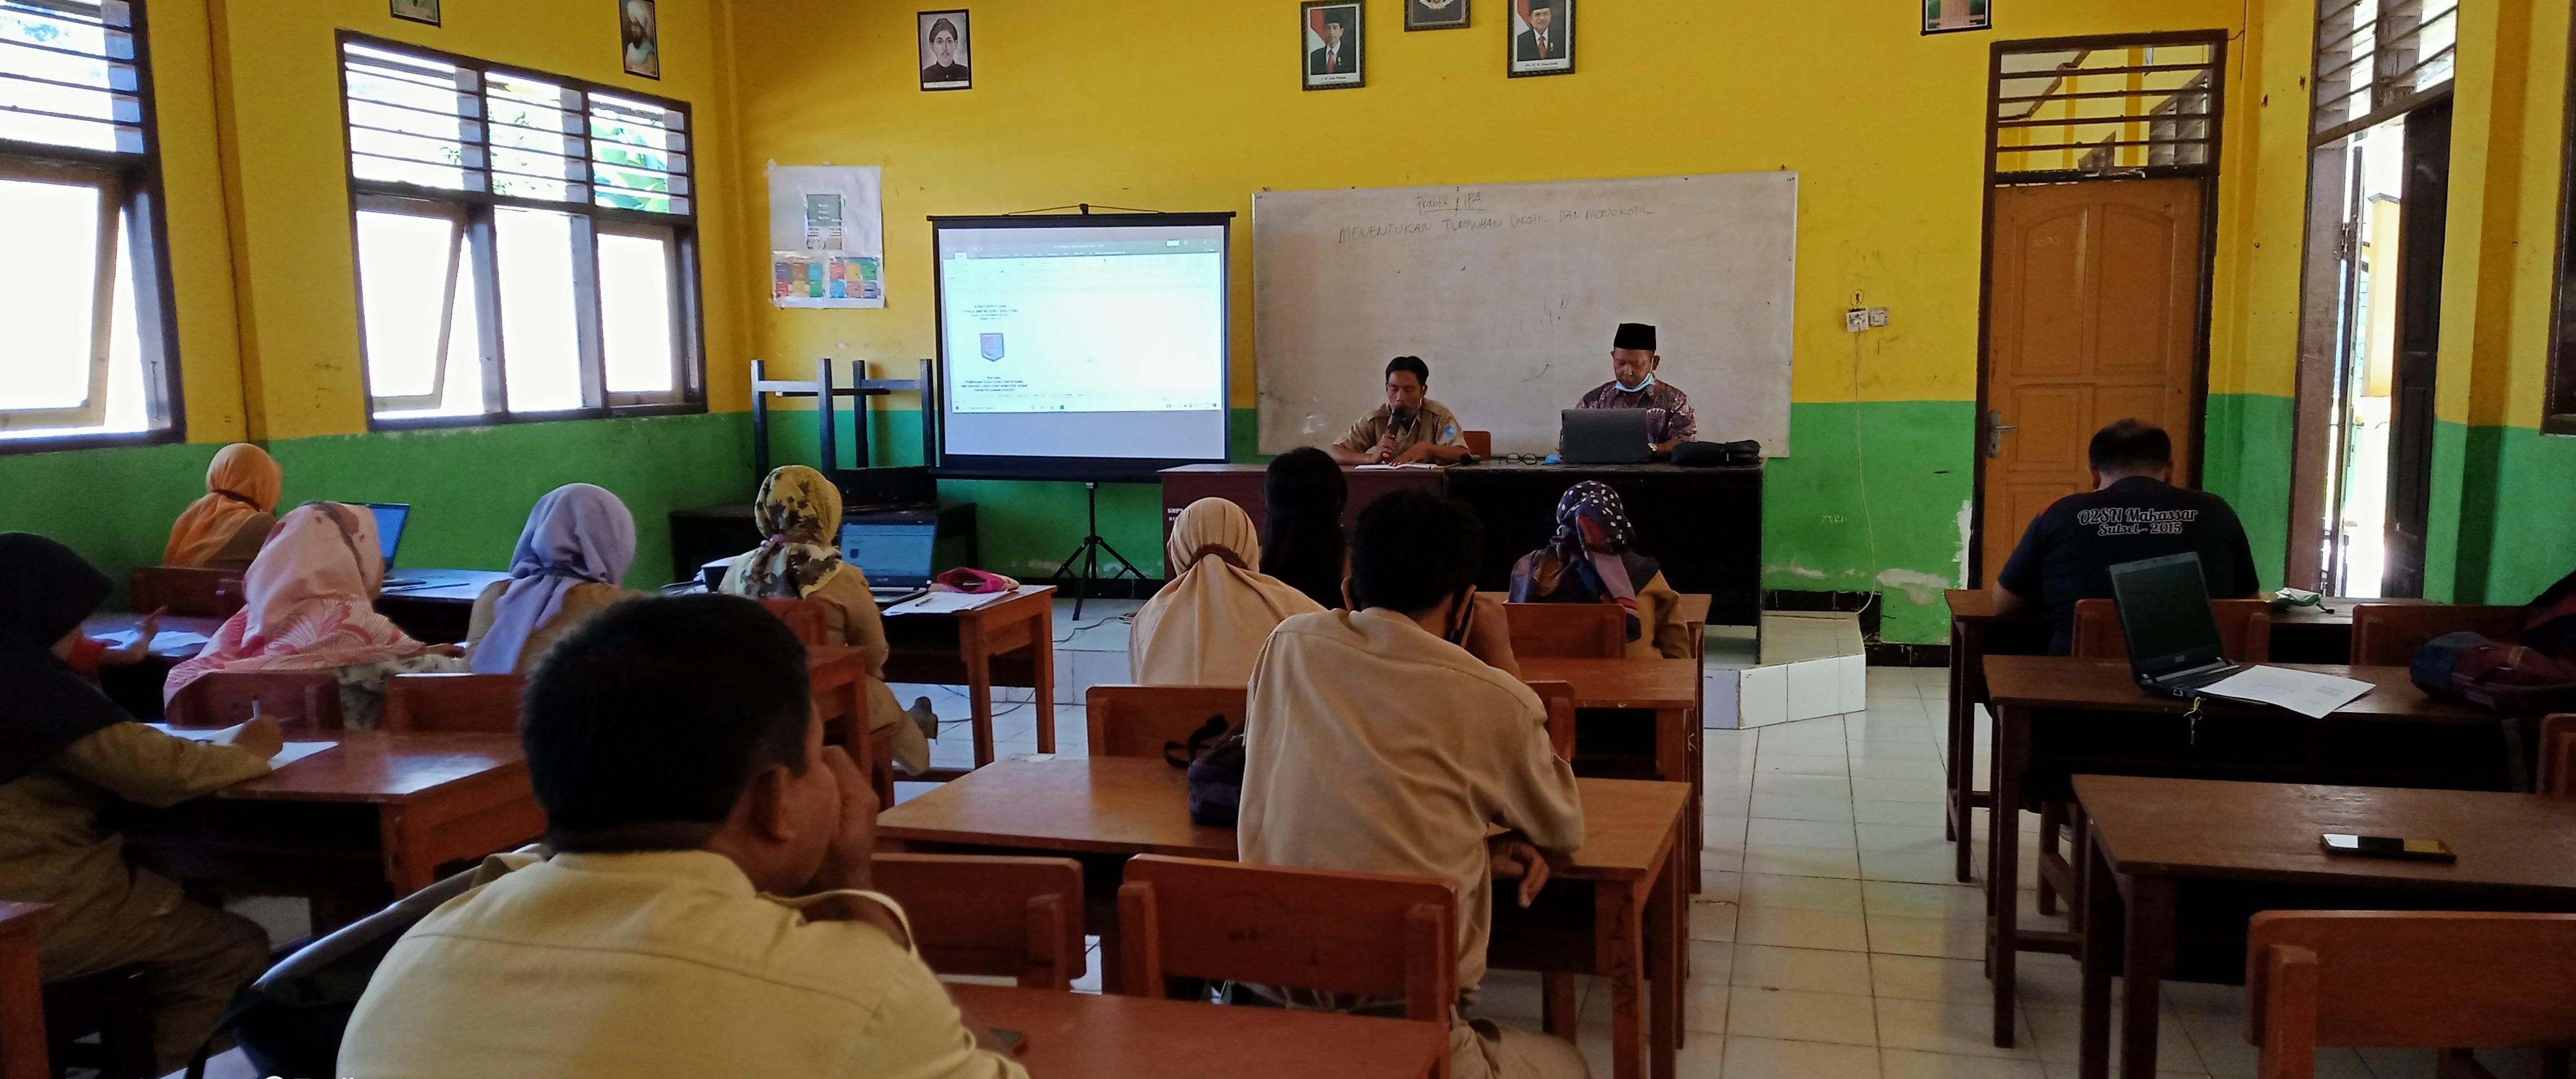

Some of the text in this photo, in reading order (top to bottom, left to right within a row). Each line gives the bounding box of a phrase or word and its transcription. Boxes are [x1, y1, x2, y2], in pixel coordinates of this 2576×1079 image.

[1464, 192, 1482, 208] IPA
[1339, 222, 1431, 244] MENENTUKAN
[1441, 218, 1502, 231] TUMBUHAN
[1559, 209, 1580, 222] DAN
[1586, 205, 1655, 219] MONOKOTIL
[2126, 508, 2198, 523] Makassar
[2150, 522, 2182, 534] 2015
